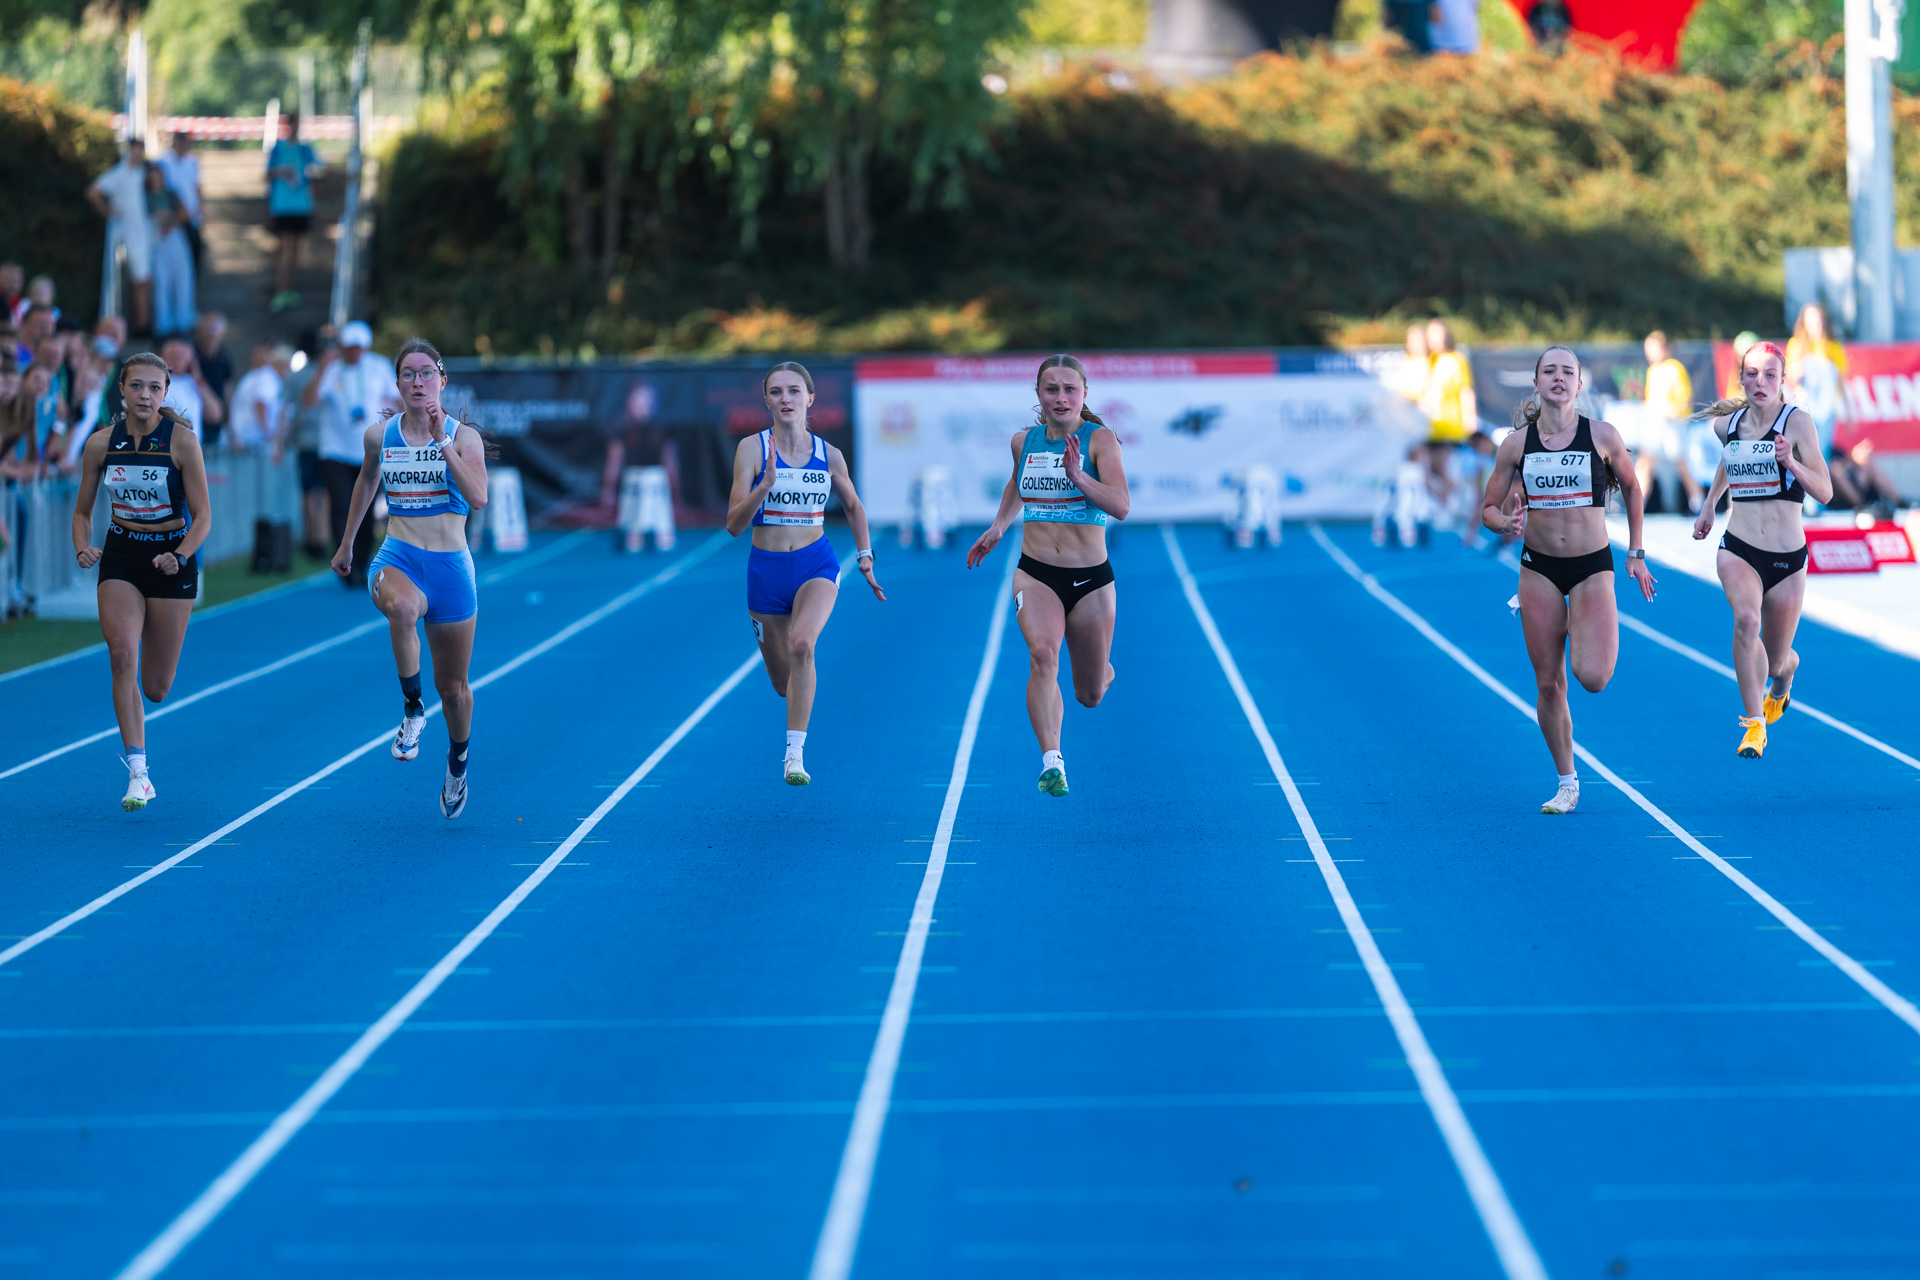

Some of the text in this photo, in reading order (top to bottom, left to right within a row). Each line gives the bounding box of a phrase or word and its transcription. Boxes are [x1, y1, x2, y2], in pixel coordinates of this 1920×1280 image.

[1752, 443, 1773, 454] 930
[415, 449, 445, 461] 1182
[1560, 454, 1585, 466] 677
[142, 469, 158, 481] 56
[1725, 462, 1777, 477] MISIARCZYK
[383, 470, 445, 485] KACPRZAK
[802, 472, 826, 484] 688
[1535, 475, 1579, 488] GUZIK
[767, 491, 827, 505] MORYTO
[1051, 511, 1088, 520] PRO
[128, 531, 166, 542] NIKE
